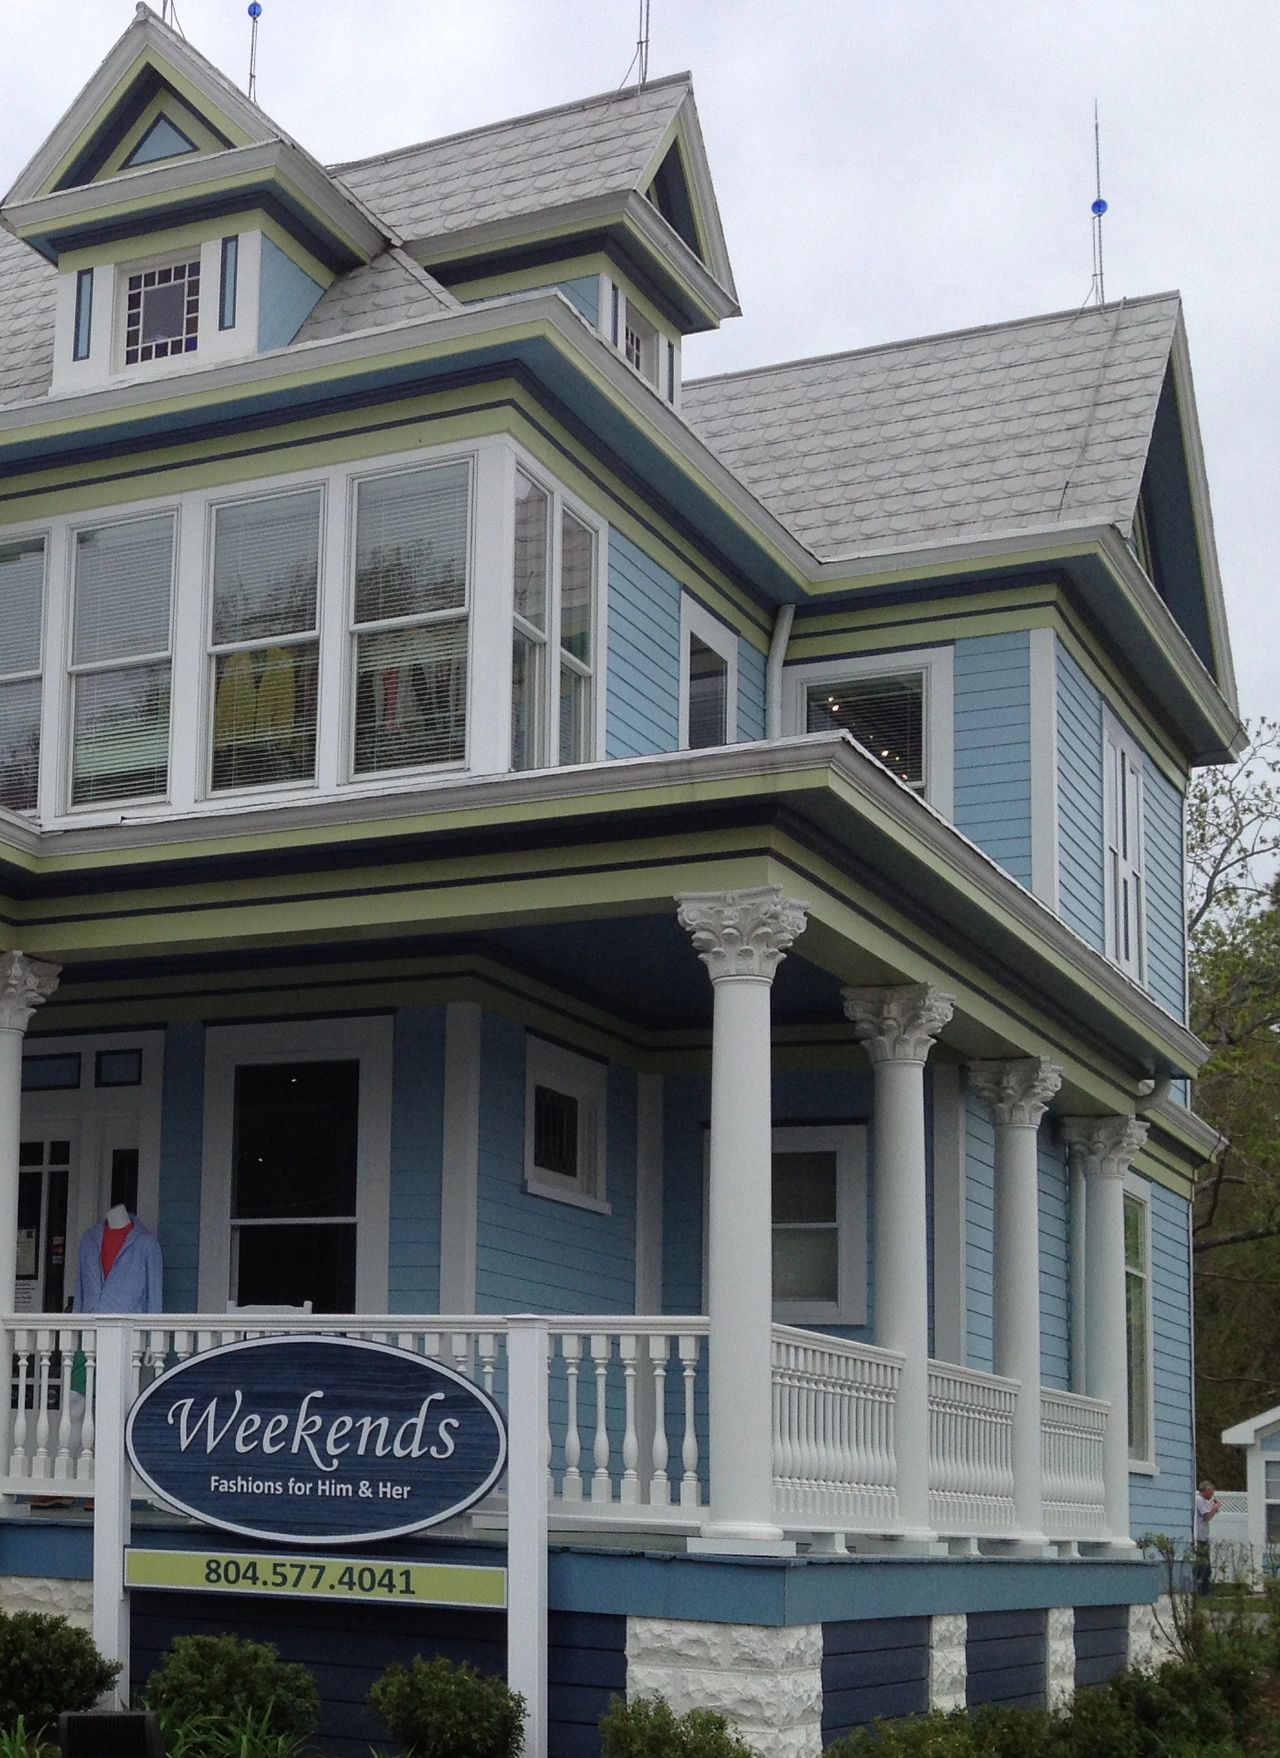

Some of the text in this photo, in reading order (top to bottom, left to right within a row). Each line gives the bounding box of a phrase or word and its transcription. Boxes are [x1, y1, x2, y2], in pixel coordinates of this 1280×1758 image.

[167, 1389, 460, 1472] Weekends
[210, 1475, 411, 1500] Fashions for Him & Her
[204, 1558, 416, 1596] 804.577.4041
